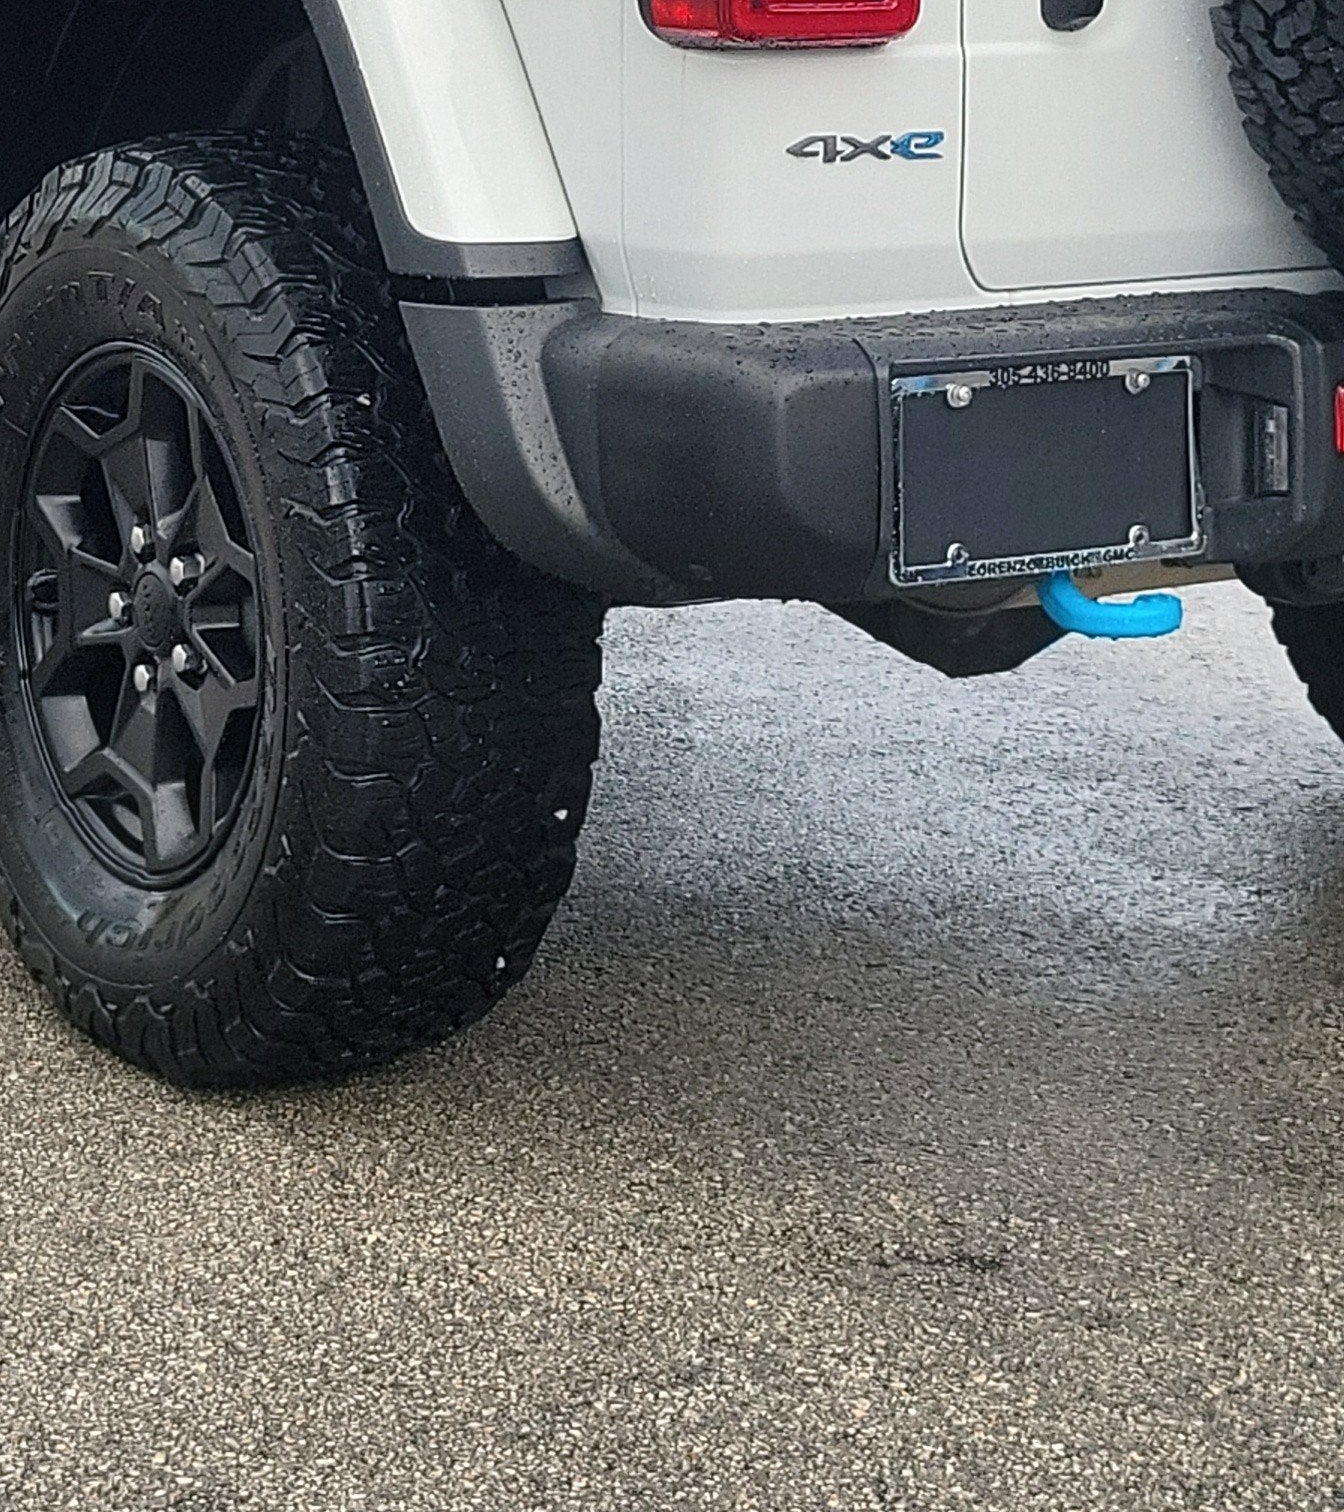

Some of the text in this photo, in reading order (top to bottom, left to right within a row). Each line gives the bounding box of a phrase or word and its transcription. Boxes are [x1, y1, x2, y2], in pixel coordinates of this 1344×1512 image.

[967, 549, 1137, 578] LORENZO BUICK GMC
